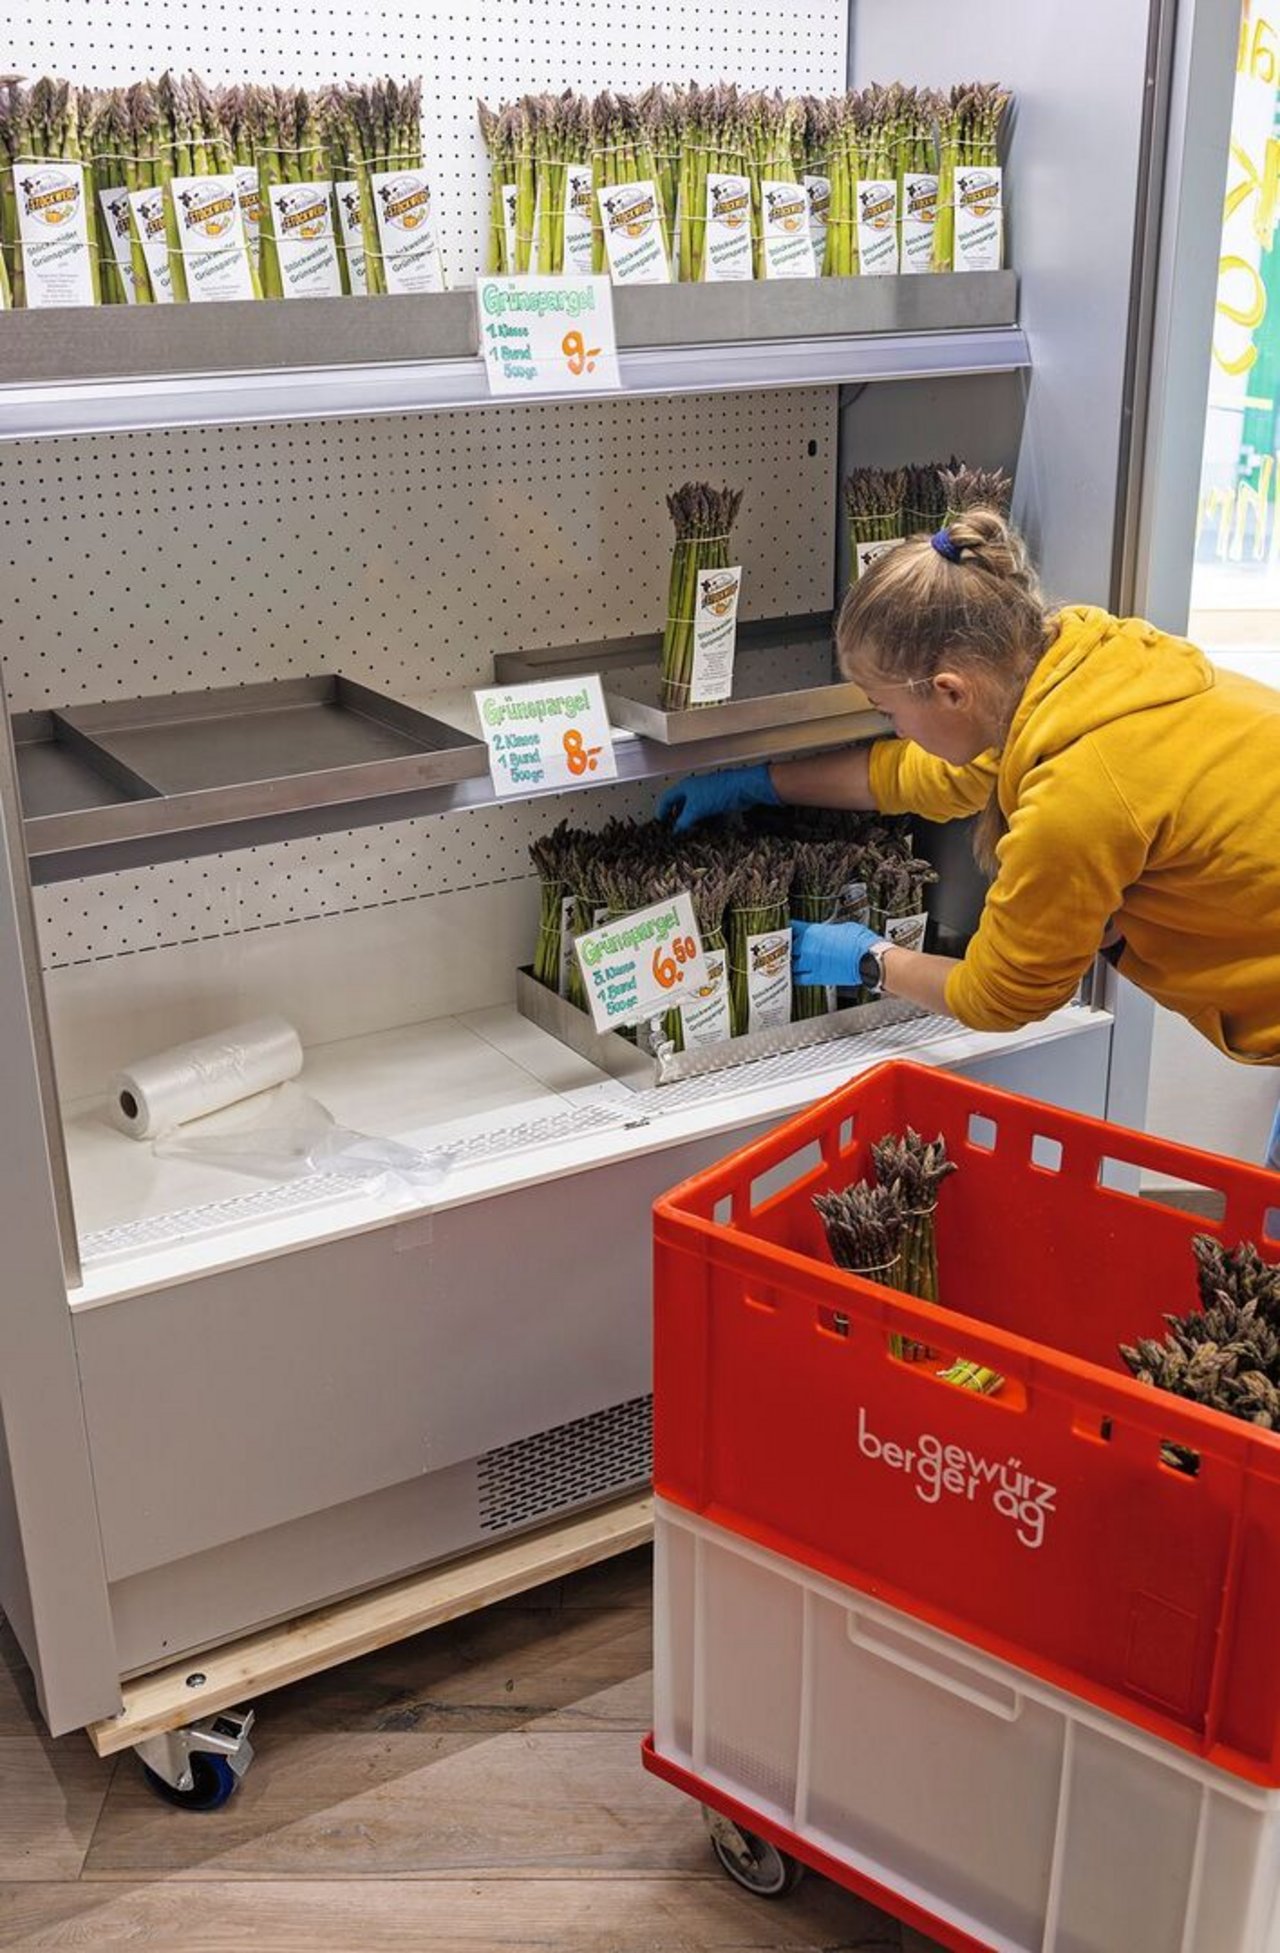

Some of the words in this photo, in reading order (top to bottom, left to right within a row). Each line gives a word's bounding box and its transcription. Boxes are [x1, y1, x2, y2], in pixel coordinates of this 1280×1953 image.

[482, 283, 596, 318] Grünspargel
[483, 688, 591, 727] Grünspargel
[581, 905, 681, 967] Grünspargel
[858, 1406, 981, 1504] berger
[993, 1488, 1045, 1549] ag
[918, 1433, 1057, 1512] gewürz
